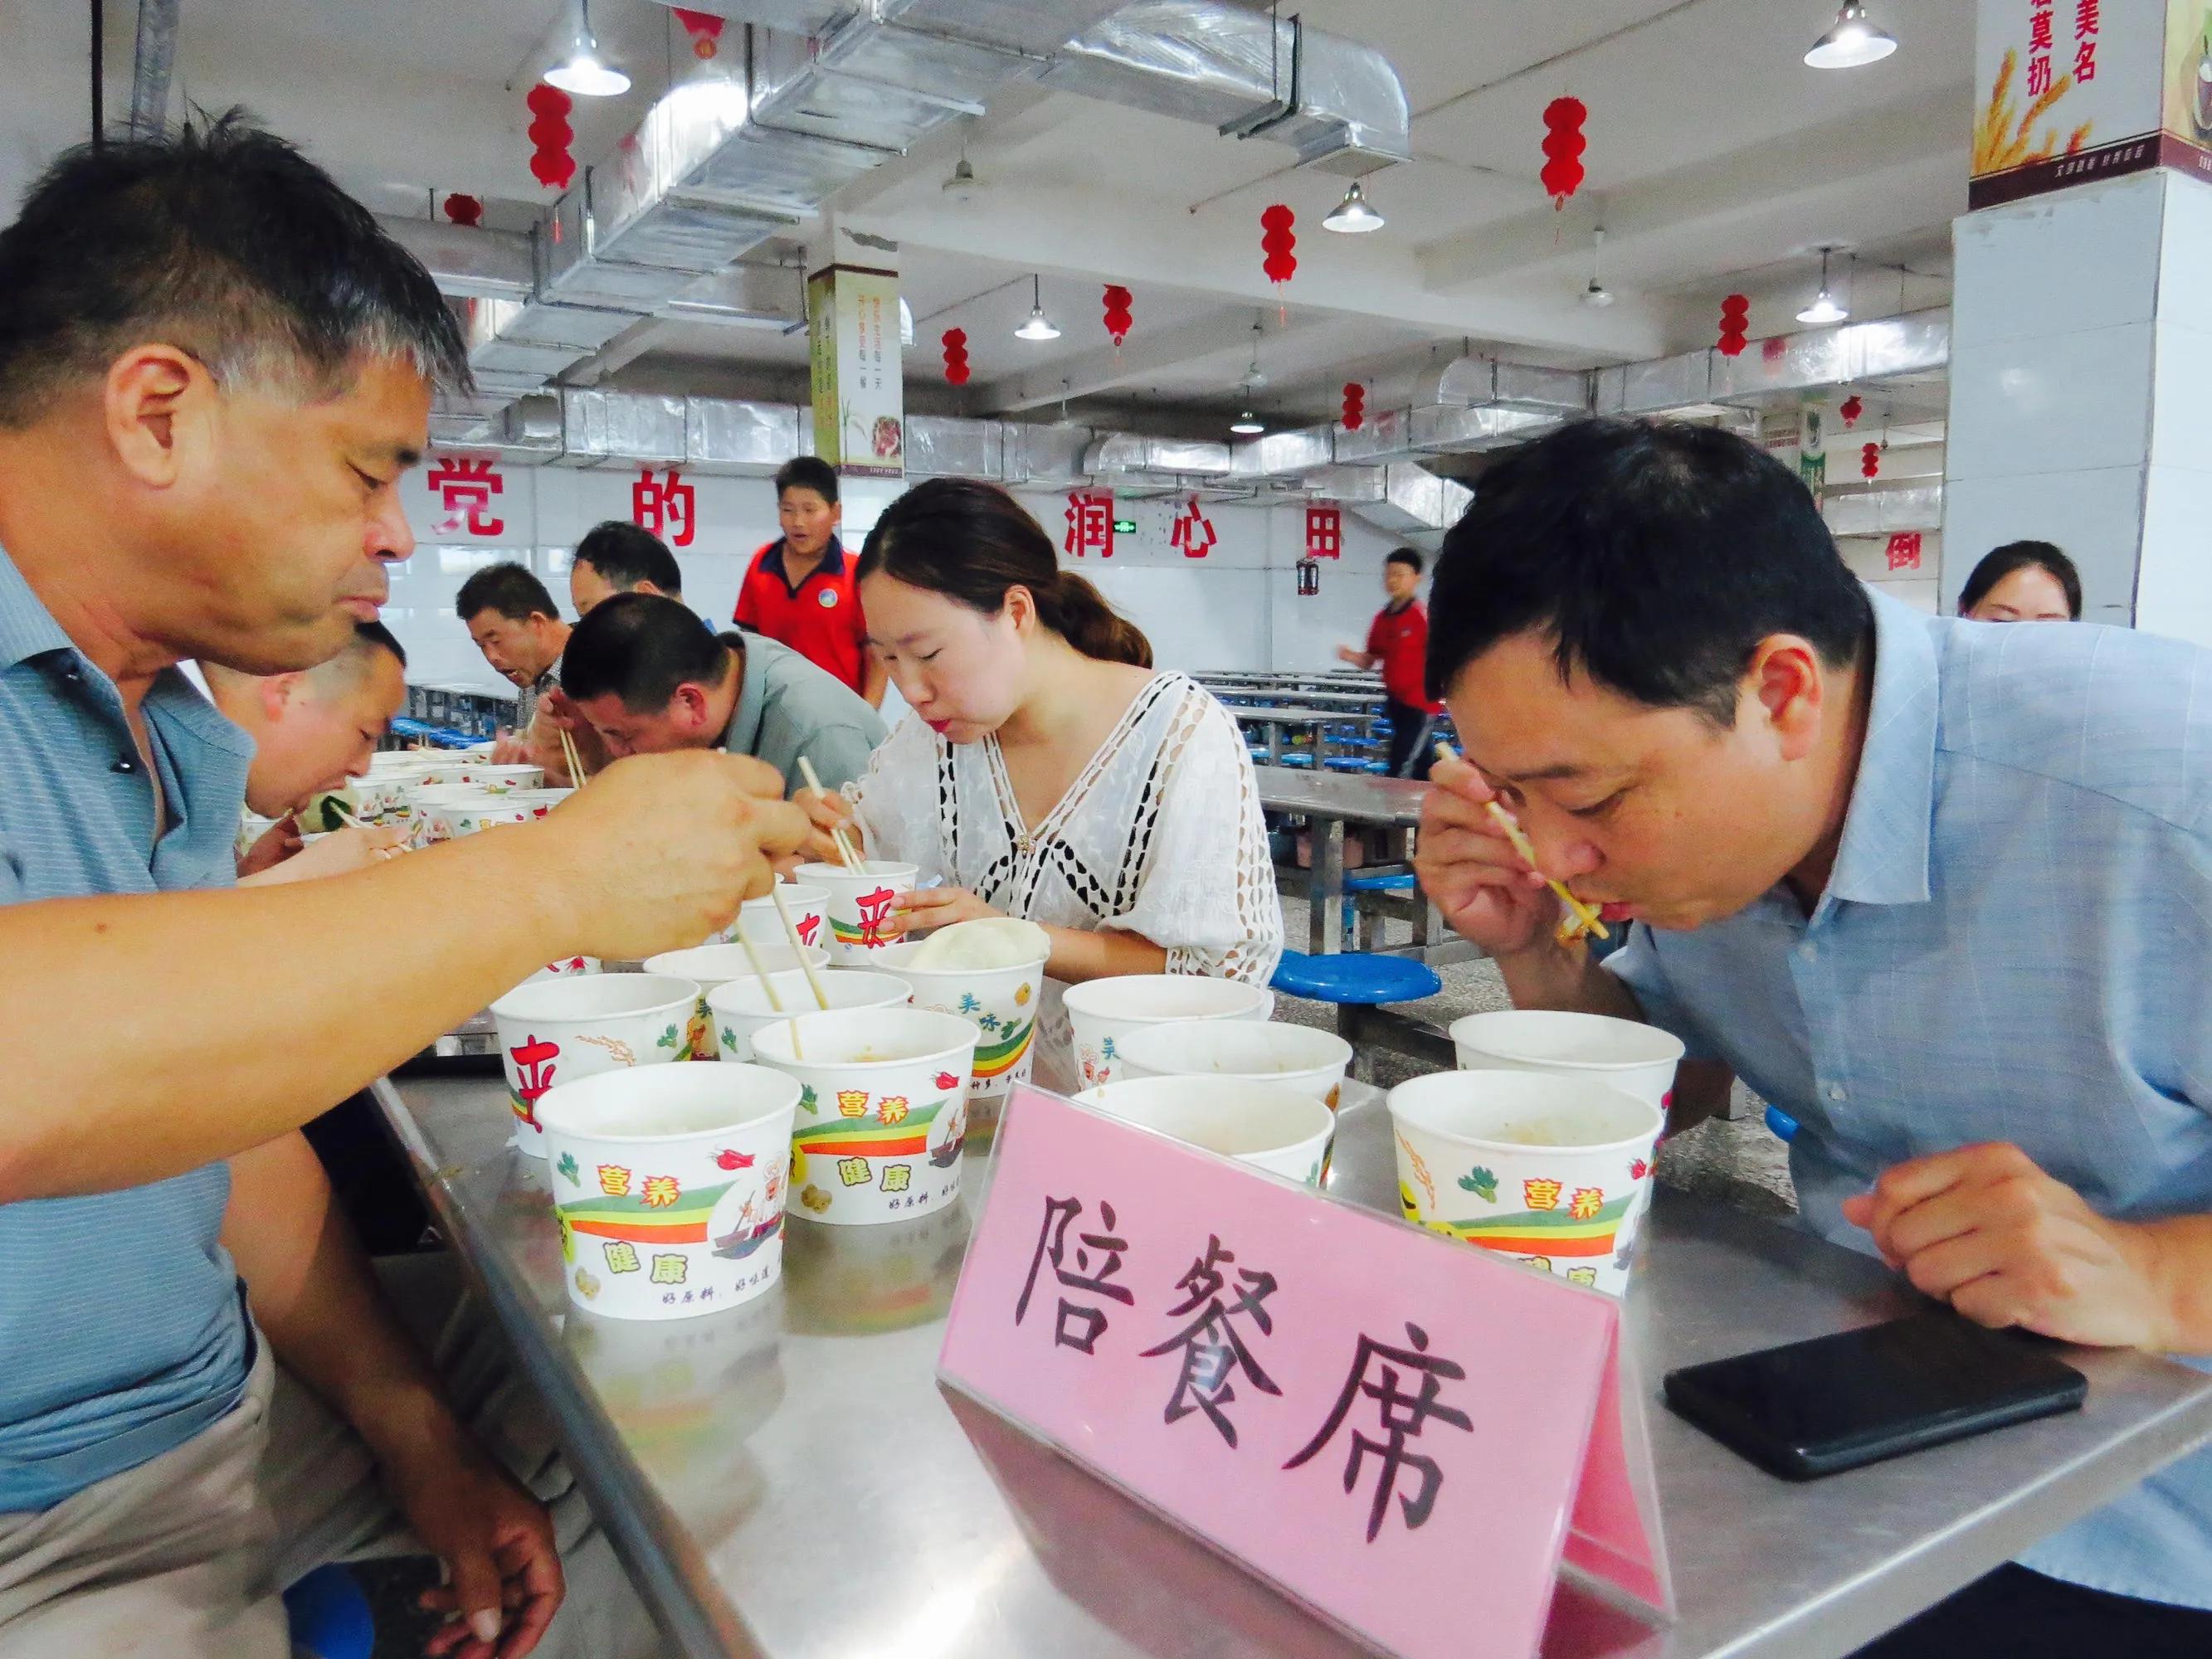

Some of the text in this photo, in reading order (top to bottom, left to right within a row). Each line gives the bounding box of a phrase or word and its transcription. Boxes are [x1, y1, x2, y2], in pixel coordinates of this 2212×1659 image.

[836, 1089, 910, 1126] 营养
[597, 1162, 683, 1209] 营养
[836, 1155, 911, 1192] 健康
[1522, 1176, 1605, 1222] 营养
[603, 1239, 689, 1286] 健康
[1015, 1195, 1475, 1545] 陪餐席
